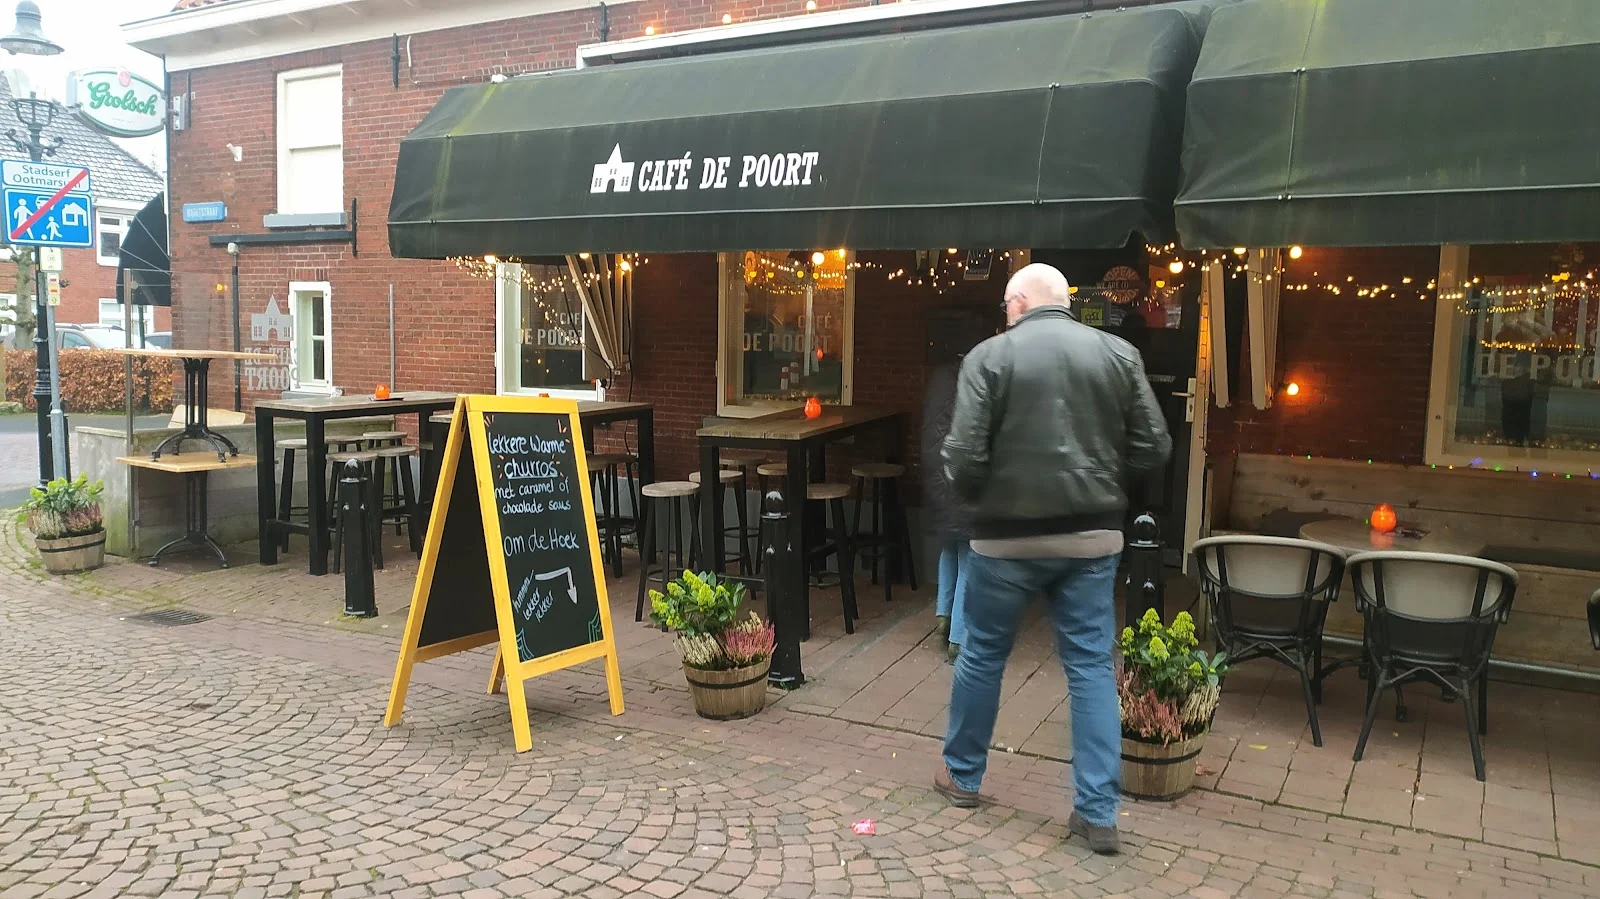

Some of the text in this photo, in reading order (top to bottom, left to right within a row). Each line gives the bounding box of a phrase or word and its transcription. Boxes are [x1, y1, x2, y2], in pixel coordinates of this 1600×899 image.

[87, 81, 158, 116] Grolsch
[22, 165, 71, 178] Stadserf
[638, 151, 819, 192] CAFÉ DE POORT
[1105, 266, 1136, 281] OPEN
[504, 458, 558, 478] churros
[494, 476, 569, 499] met caramel of
[548, 500, 571, 511] saus
[528, 527, 549, 552] de
[549, 528, 580, 551] Hoek
